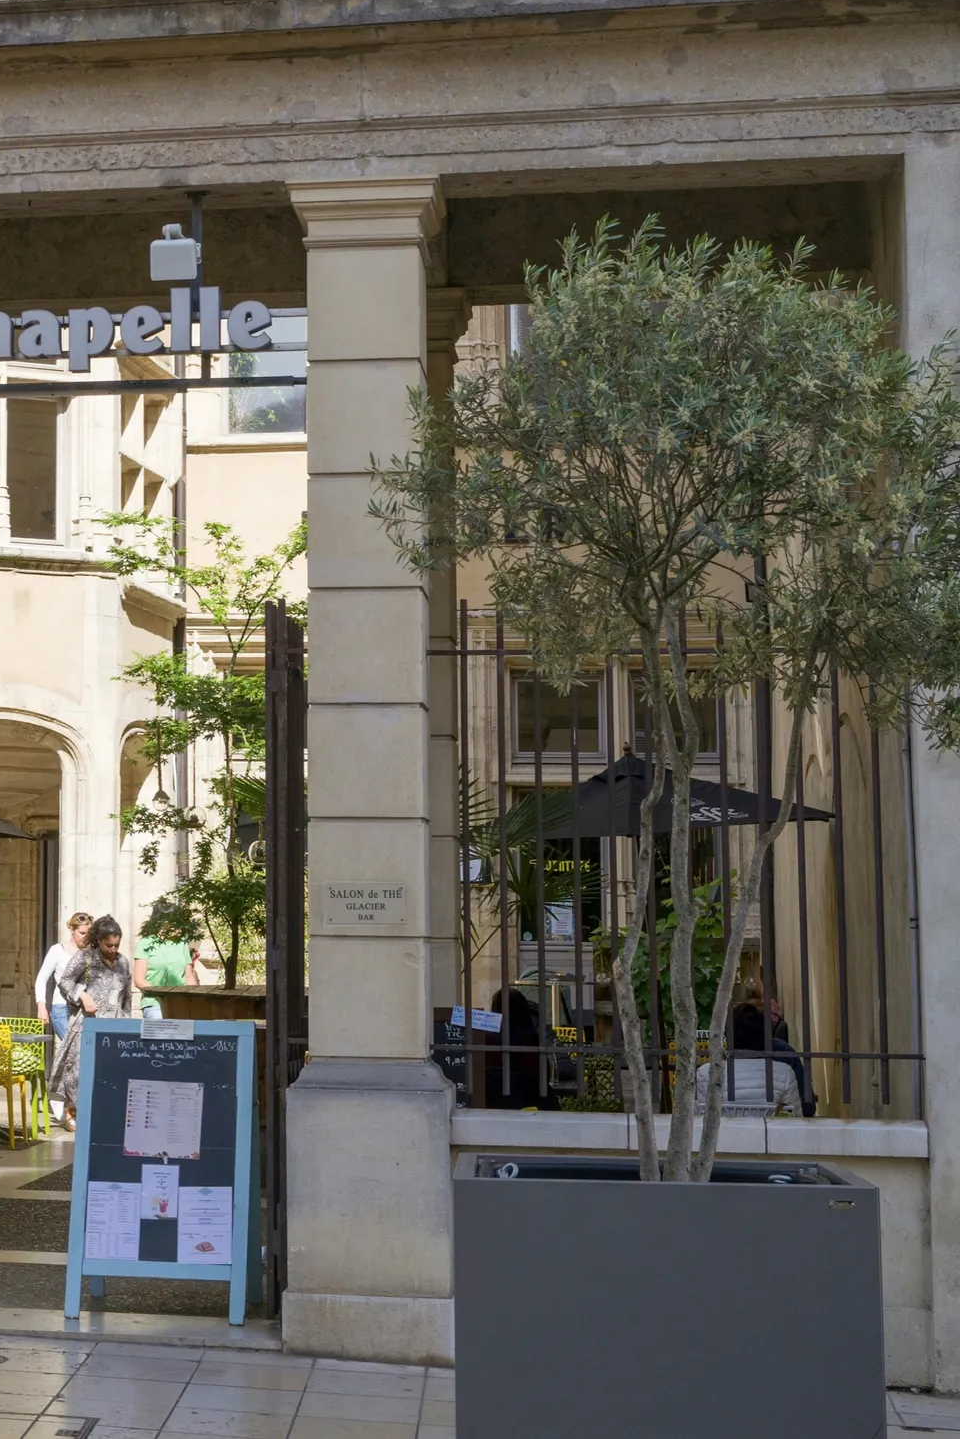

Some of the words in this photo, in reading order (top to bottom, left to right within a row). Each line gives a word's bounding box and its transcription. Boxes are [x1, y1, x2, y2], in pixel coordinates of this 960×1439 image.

[329, 889, 364, 899] SALON
[368, 890, 378, 899] de
[382, 887, 403, 899] THÉ
[346, 902, 386, 910] GLACIER
[150, 1043, 158, 1051] de
